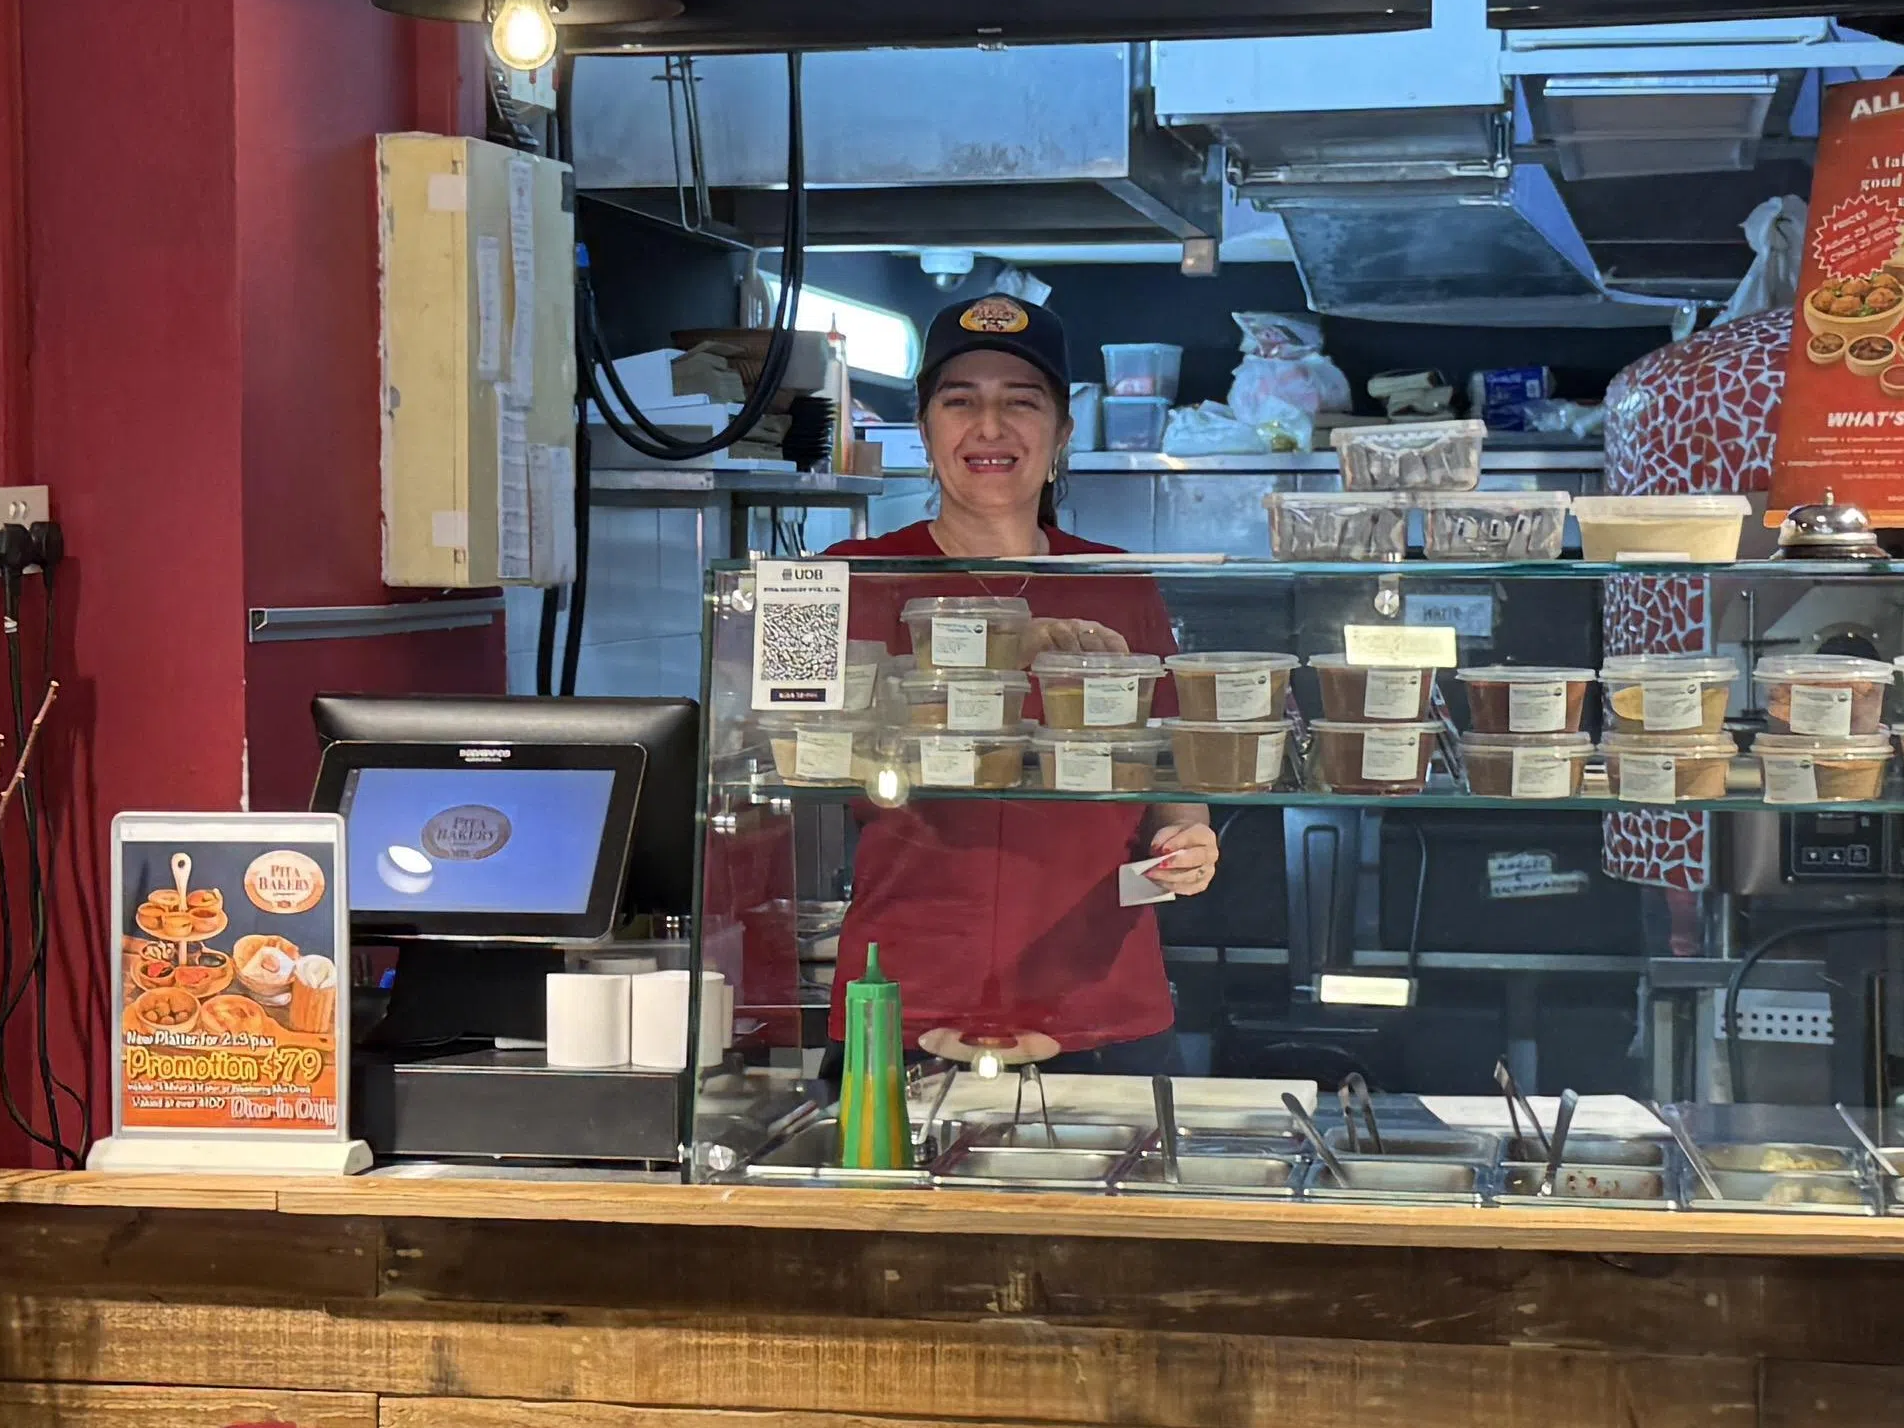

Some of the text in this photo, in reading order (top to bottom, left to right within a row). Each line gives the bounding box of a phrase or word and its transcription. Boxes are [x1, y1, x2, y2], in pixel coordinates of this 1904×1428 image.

[1860, 173, 1902, 191] good
[795, 568, 823, 580] UOB
[453, 816, 487, 829] PITA
[436, 828, 497, 841] BAKERY
[270, 864, 301, 878] PITA
[259, 877, 310, 891] BAKERY
[126, 1031, 276, 1050] New Platter for pax
[126, 1045, 324, 1083] Promotion $79
